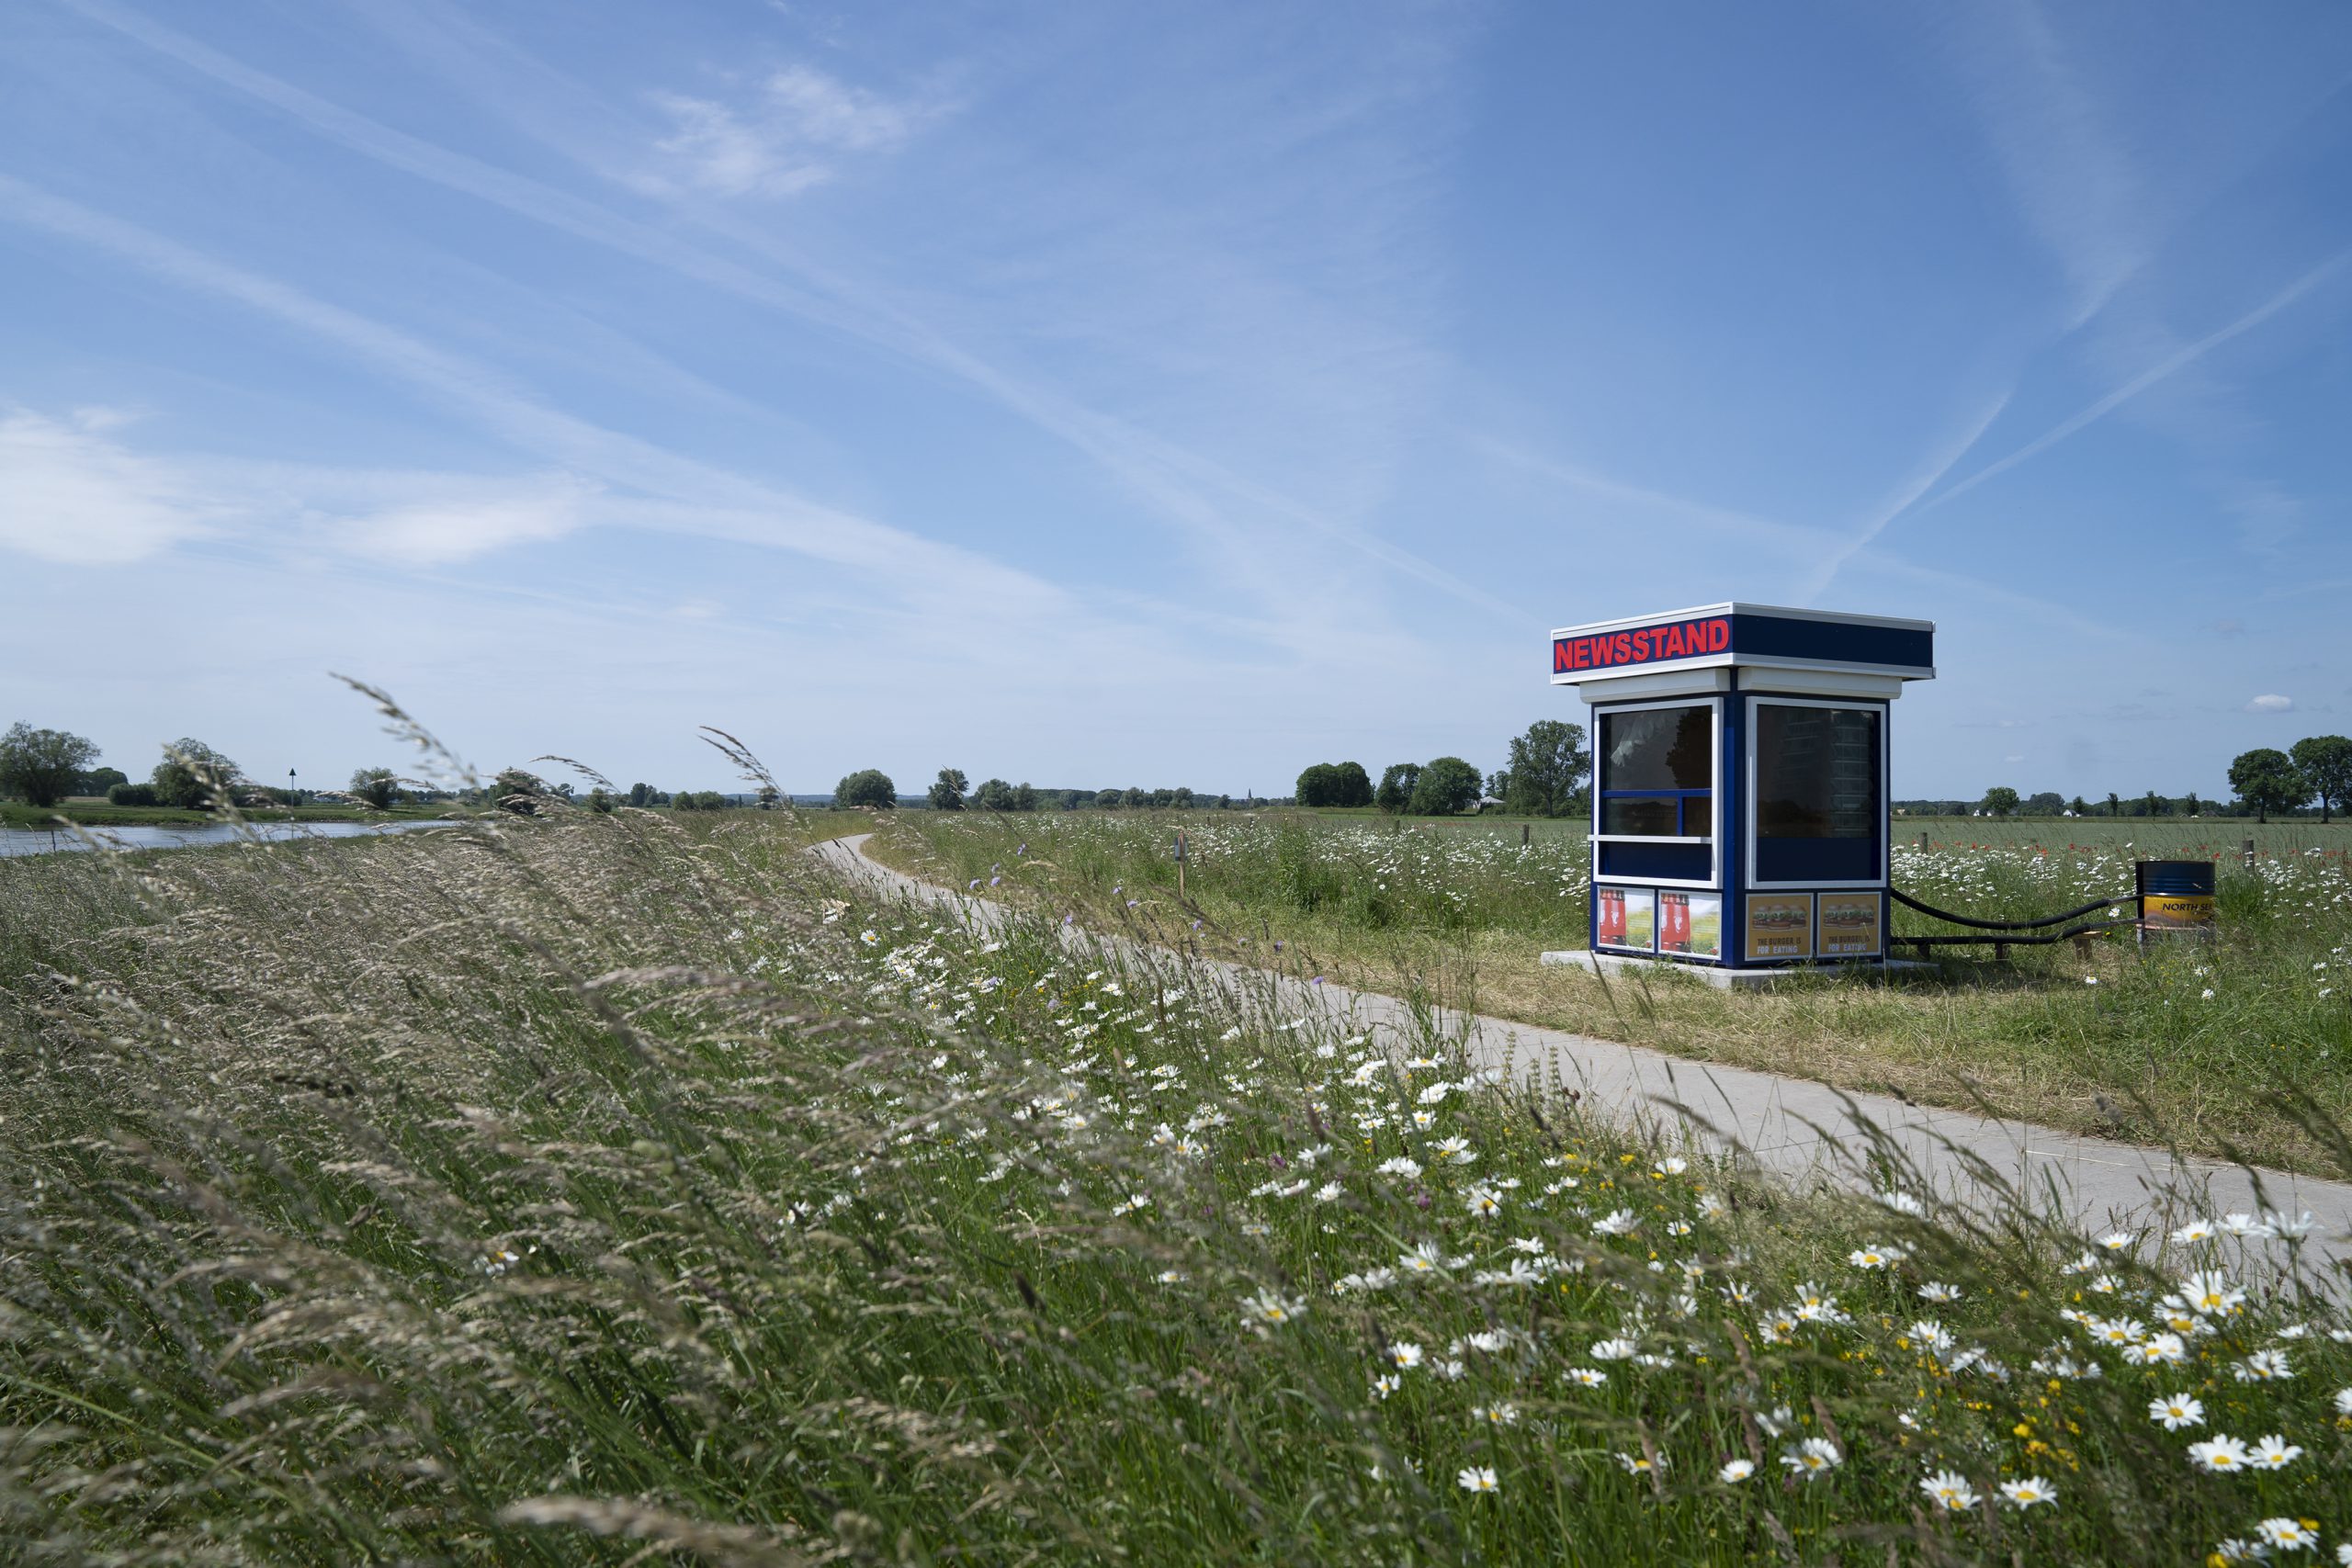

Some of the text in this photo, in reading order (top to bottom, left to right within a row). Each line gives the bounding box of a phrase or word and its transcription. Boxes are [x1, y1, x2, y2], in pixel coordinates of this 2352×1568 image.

[1555, 620, 1729, 670] NEWSSTAND
[1769, 937, 1793, 945] BURGER
[1757, 945, 1798, 954] FOR EATING
